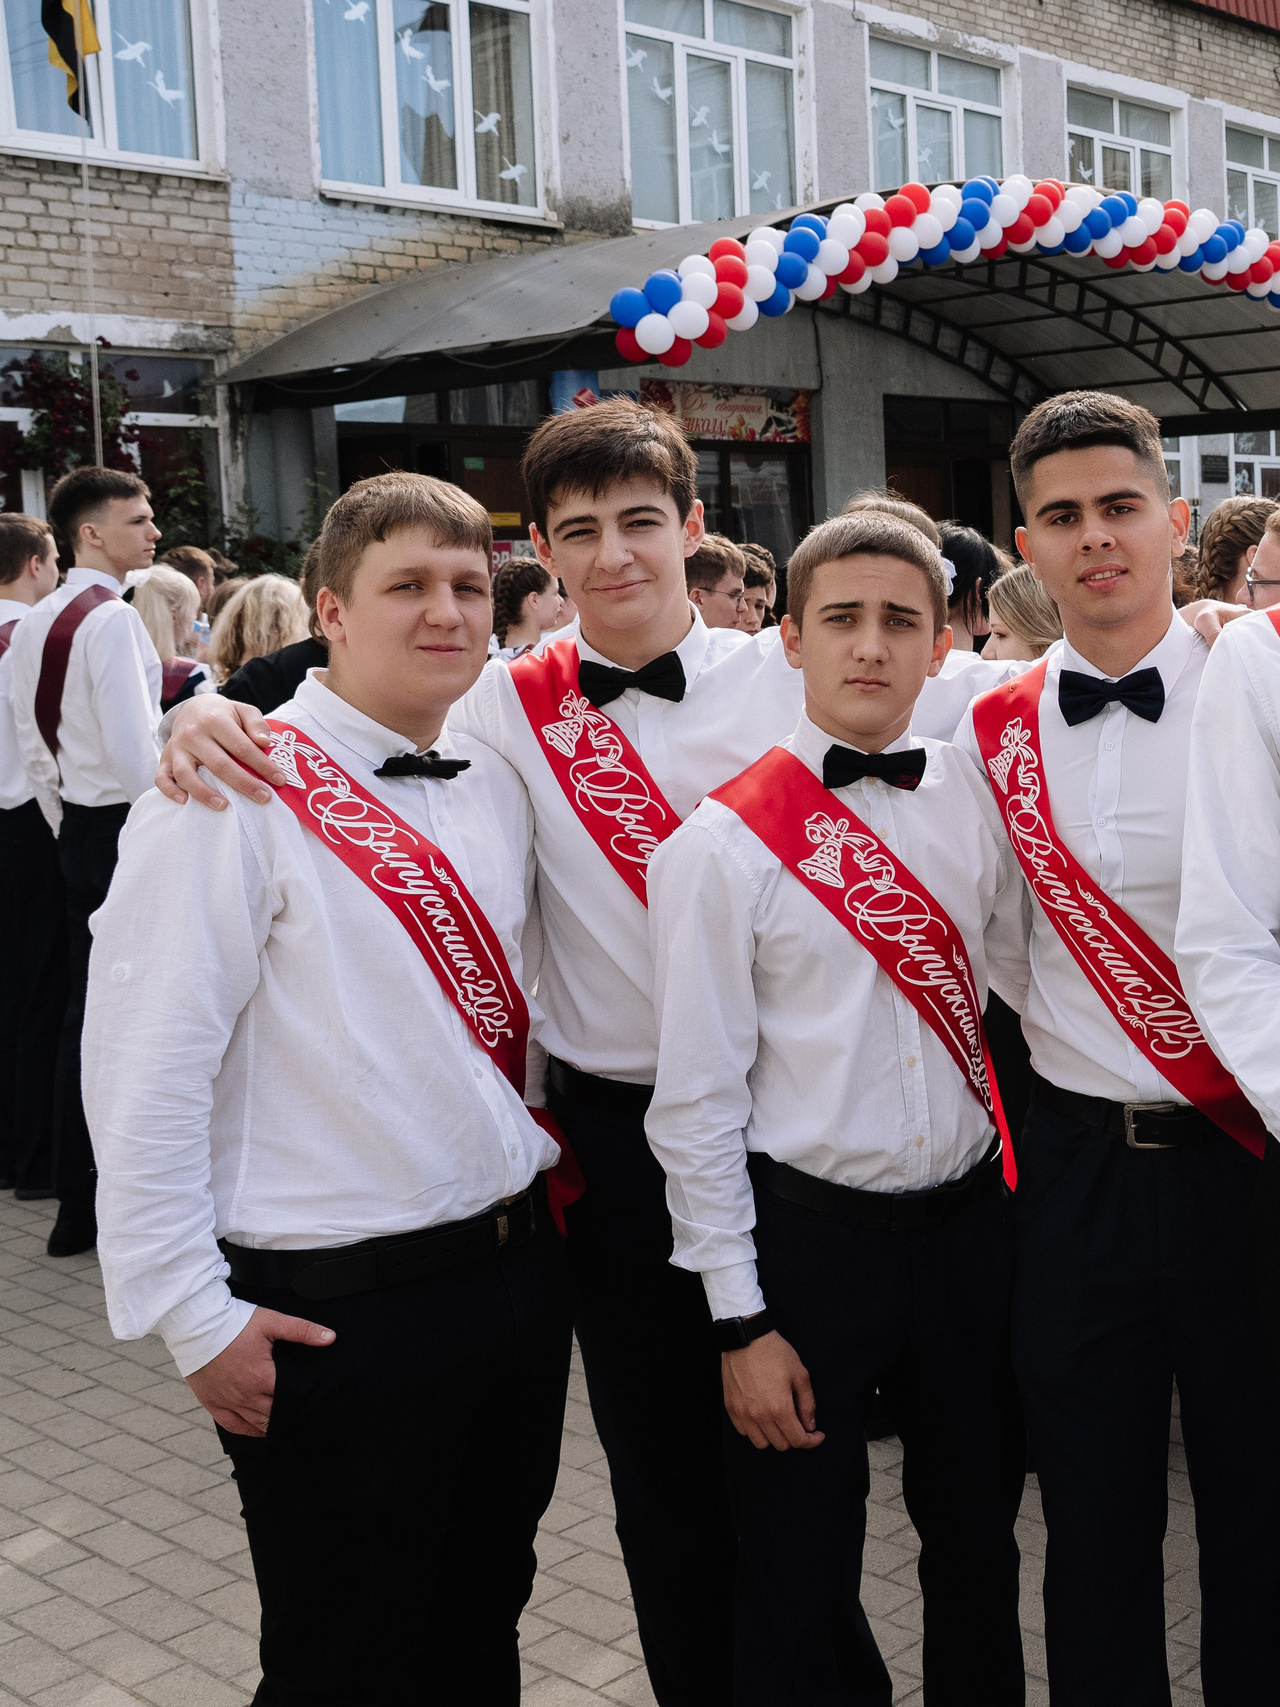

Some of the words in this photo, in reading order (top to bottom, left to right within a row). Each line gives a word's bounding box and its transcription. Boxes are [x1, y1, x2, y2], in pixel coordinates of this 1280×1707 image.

[307, 786, 482, 980] Выпускник
[461, 979, 514, 1048] 2025
[844, 879, 978, 1054] Выпускник
[1006, 794, 1152, 996] Выпускник
[1124, 994, 1207, 1060] 2025
